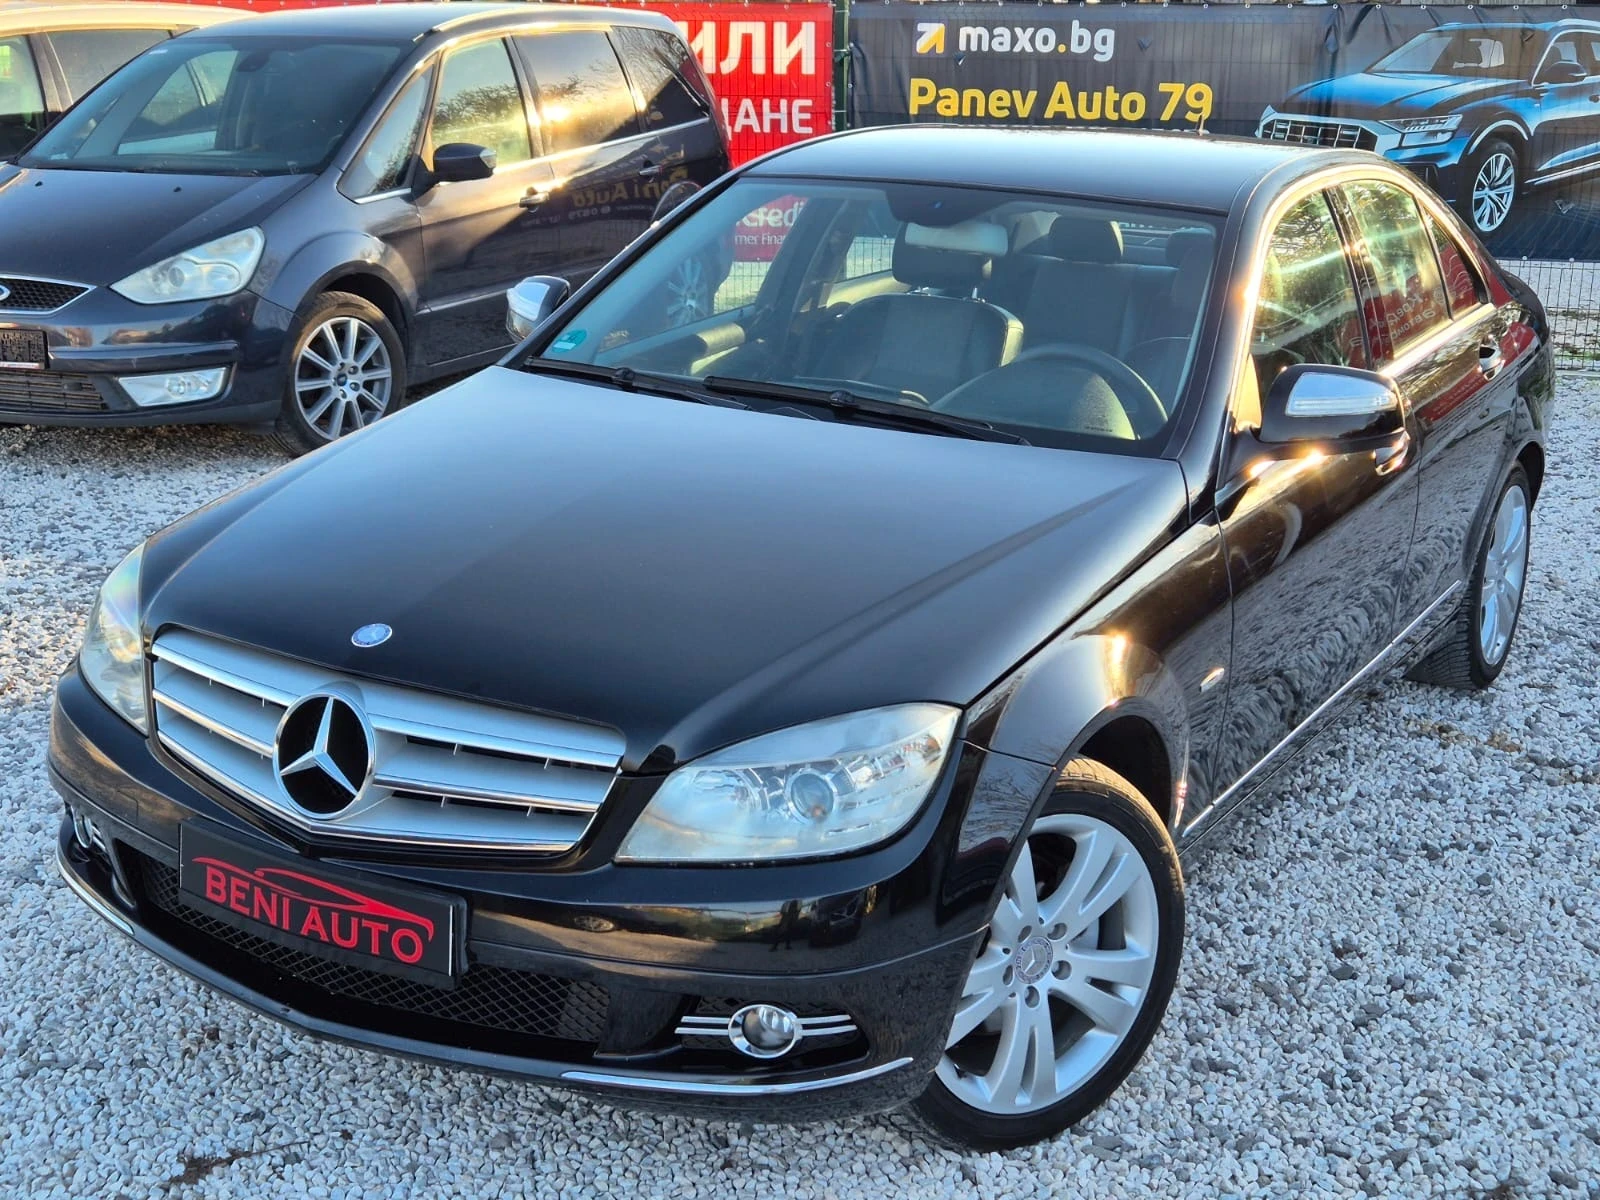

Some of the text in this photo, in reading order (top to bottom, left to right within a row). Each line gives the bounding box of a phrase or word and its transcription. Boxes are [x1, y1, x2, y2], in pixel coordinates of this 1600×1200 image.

[958, 19, 1116, 62] maxo.bg
[909, 77, 1213, 122] Panev Auto 79
[205, 865, 424, 963] BENI AUTO
